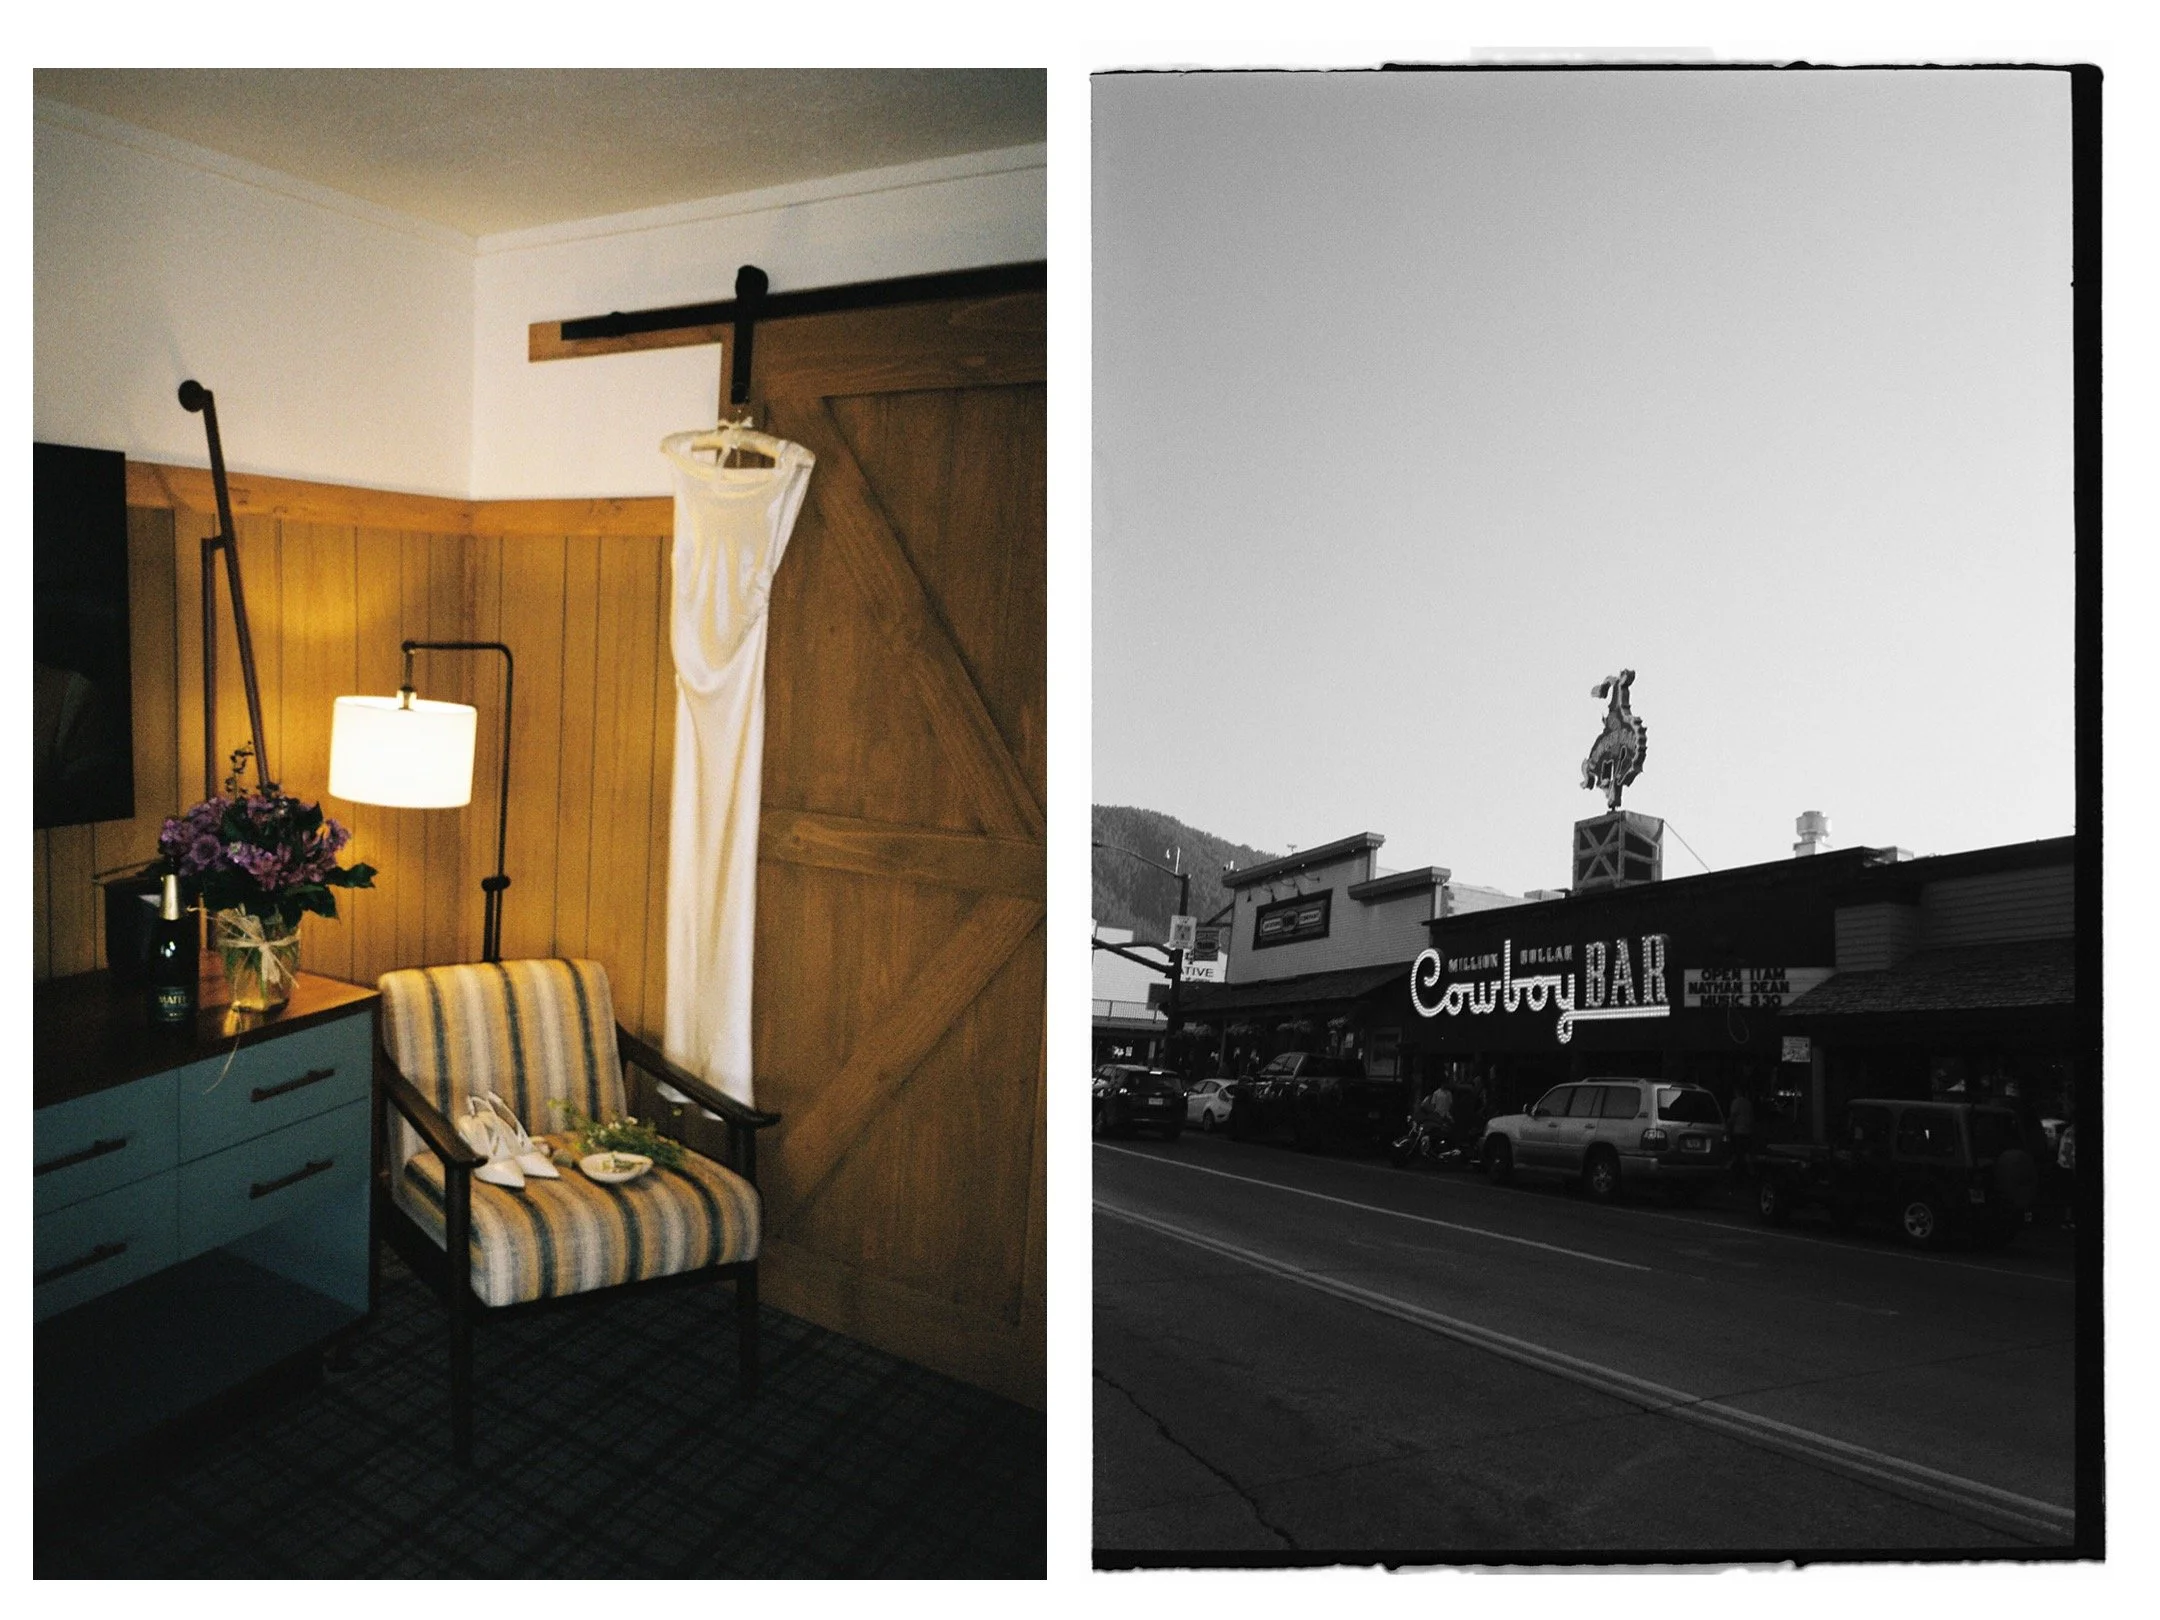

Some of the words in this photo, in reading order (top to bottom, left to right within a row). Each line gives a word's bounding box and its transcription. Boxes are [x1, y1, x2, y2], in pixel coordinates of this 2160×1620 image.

[1449, 953, 1498, 973] MILLION
[1519, 945, 1573, 966] DOLLAR
[1181, 966, 1214, 978] TIVE
[1701, 968, 1742, 981] OPEN
[1411, 939, 1575, 1044] Cowboy
[1585, 934, 1669, 1008] BAR
[1688, 981, 1743, 994] NATHAN
[1751, 981, 1790, 993] DEAN
[1701, 994, 1744, 1007] MUSIC
